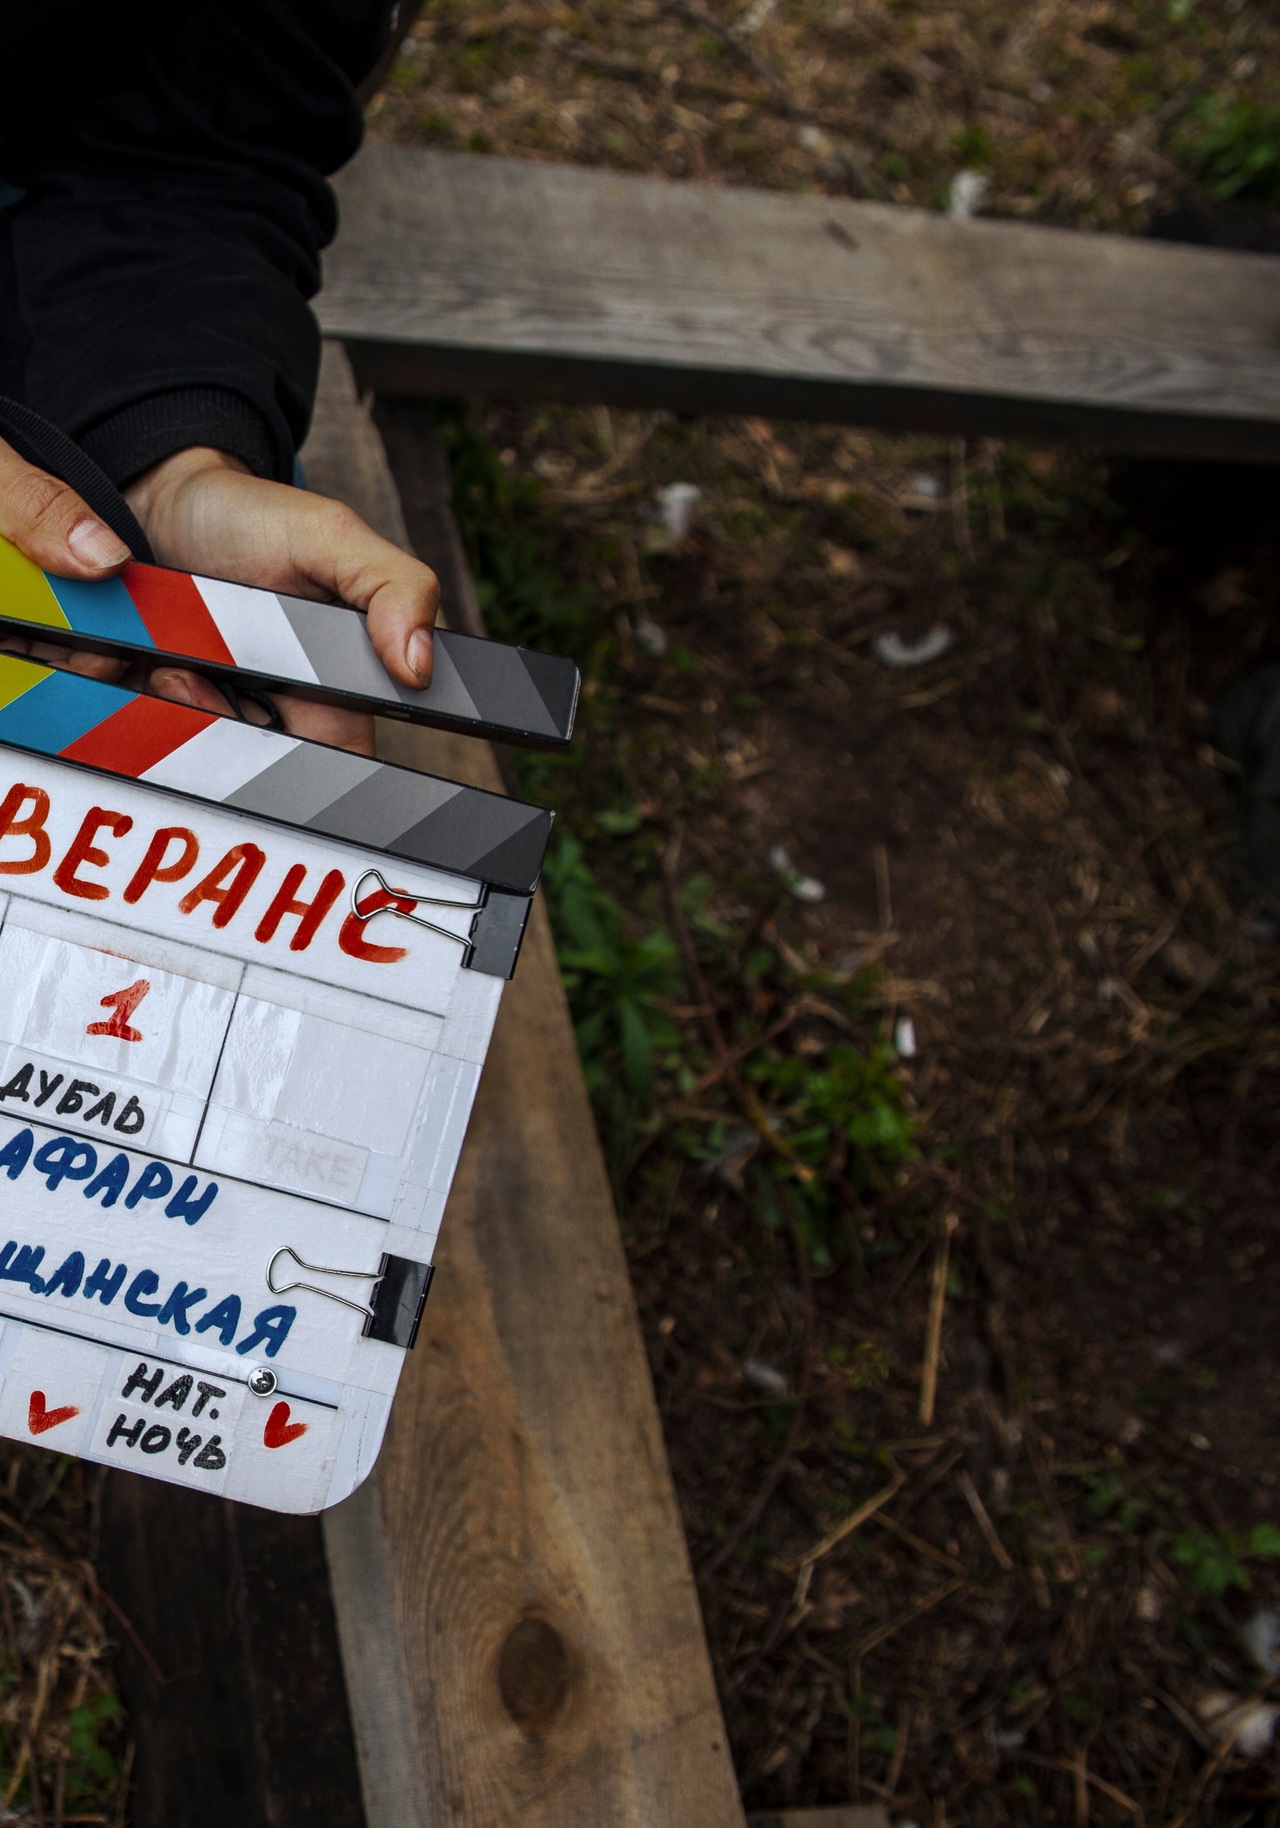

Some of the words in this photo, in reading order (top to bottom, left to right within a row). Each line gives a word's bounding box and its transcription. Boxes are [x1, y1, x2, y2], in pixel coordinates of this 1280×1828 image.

[86, 979, 150, 1043] 1
[0, 1062, 146, 1135] ДУБЛЬ
[121, 1362, 227, 1420] НАТ.
[106, 1413, 228, 1470] НОЧЬ
